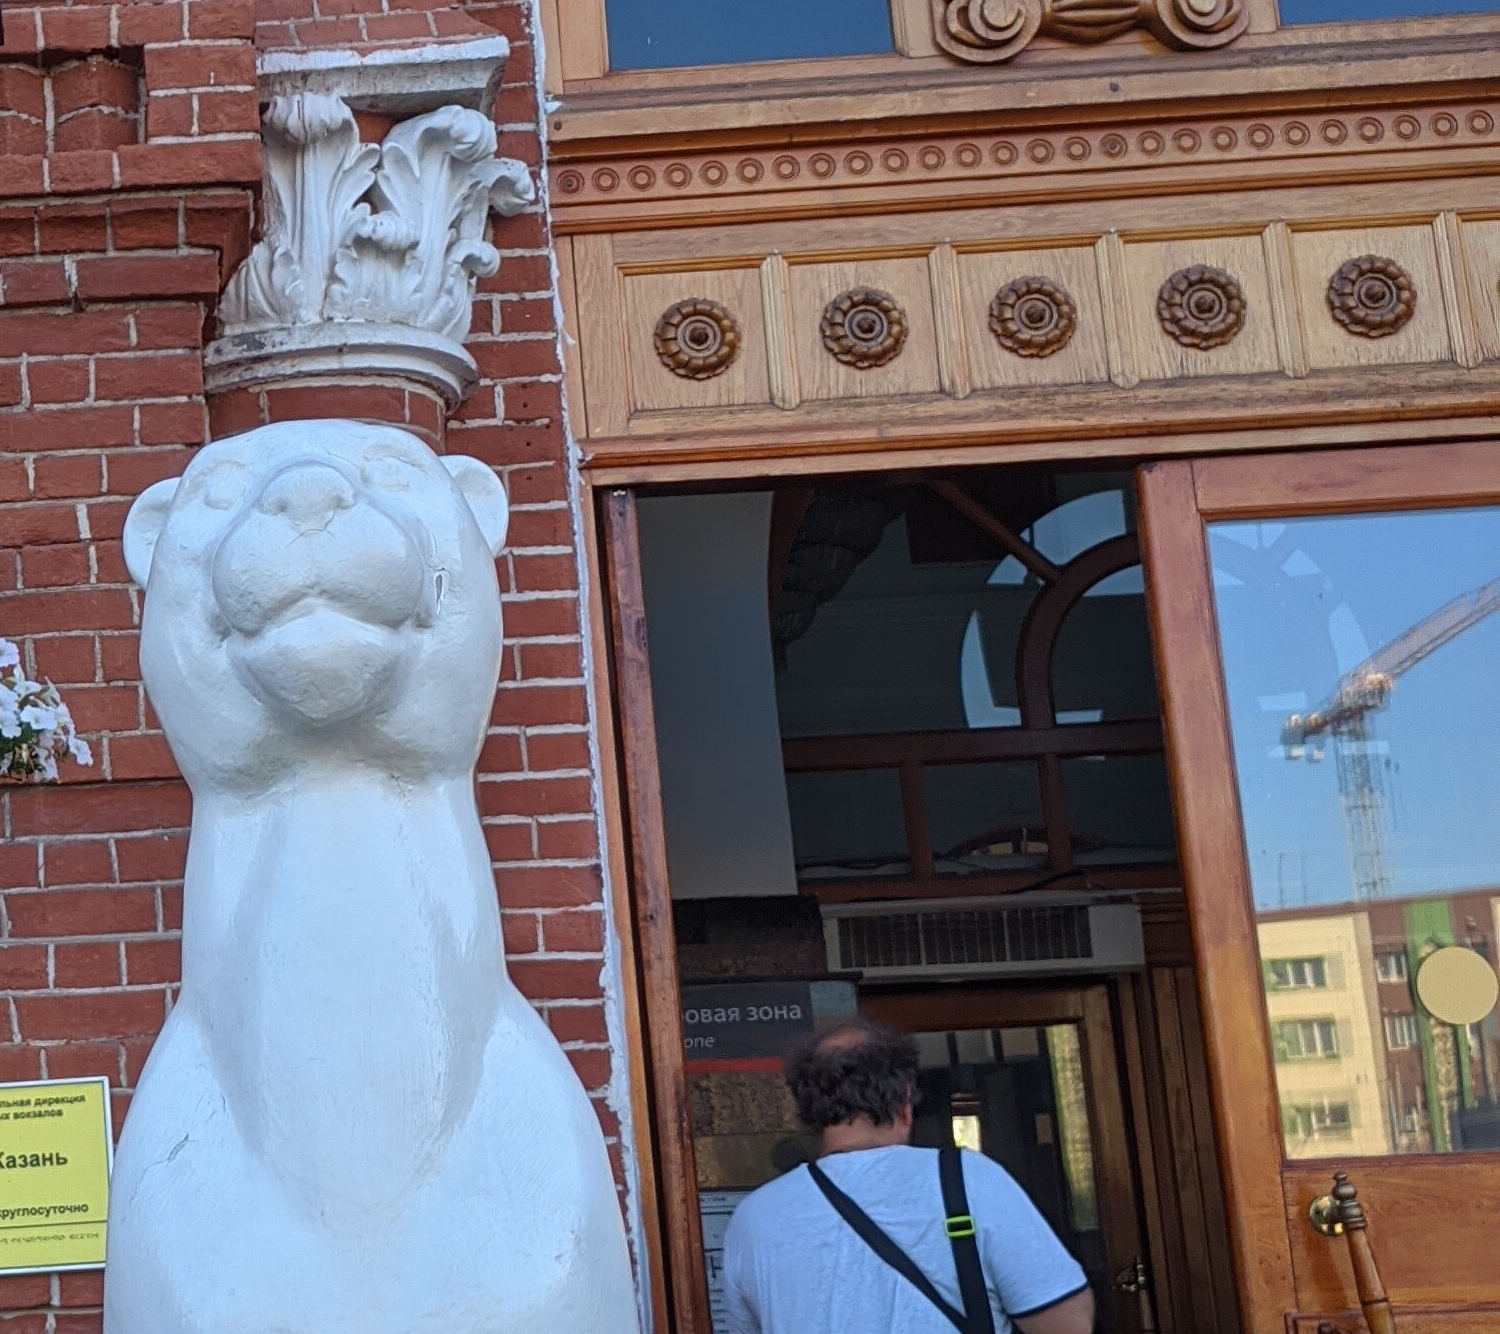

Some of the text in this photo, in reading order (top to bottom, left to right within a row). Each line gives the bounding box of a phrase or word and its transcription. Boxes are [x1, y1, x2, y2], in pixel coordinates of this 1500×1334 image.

[682, 1004, 802, 1024] овая зона
[33, 1094, 86, 1107] дирекция
[13, 1108, 63, 1120] вокзалов
